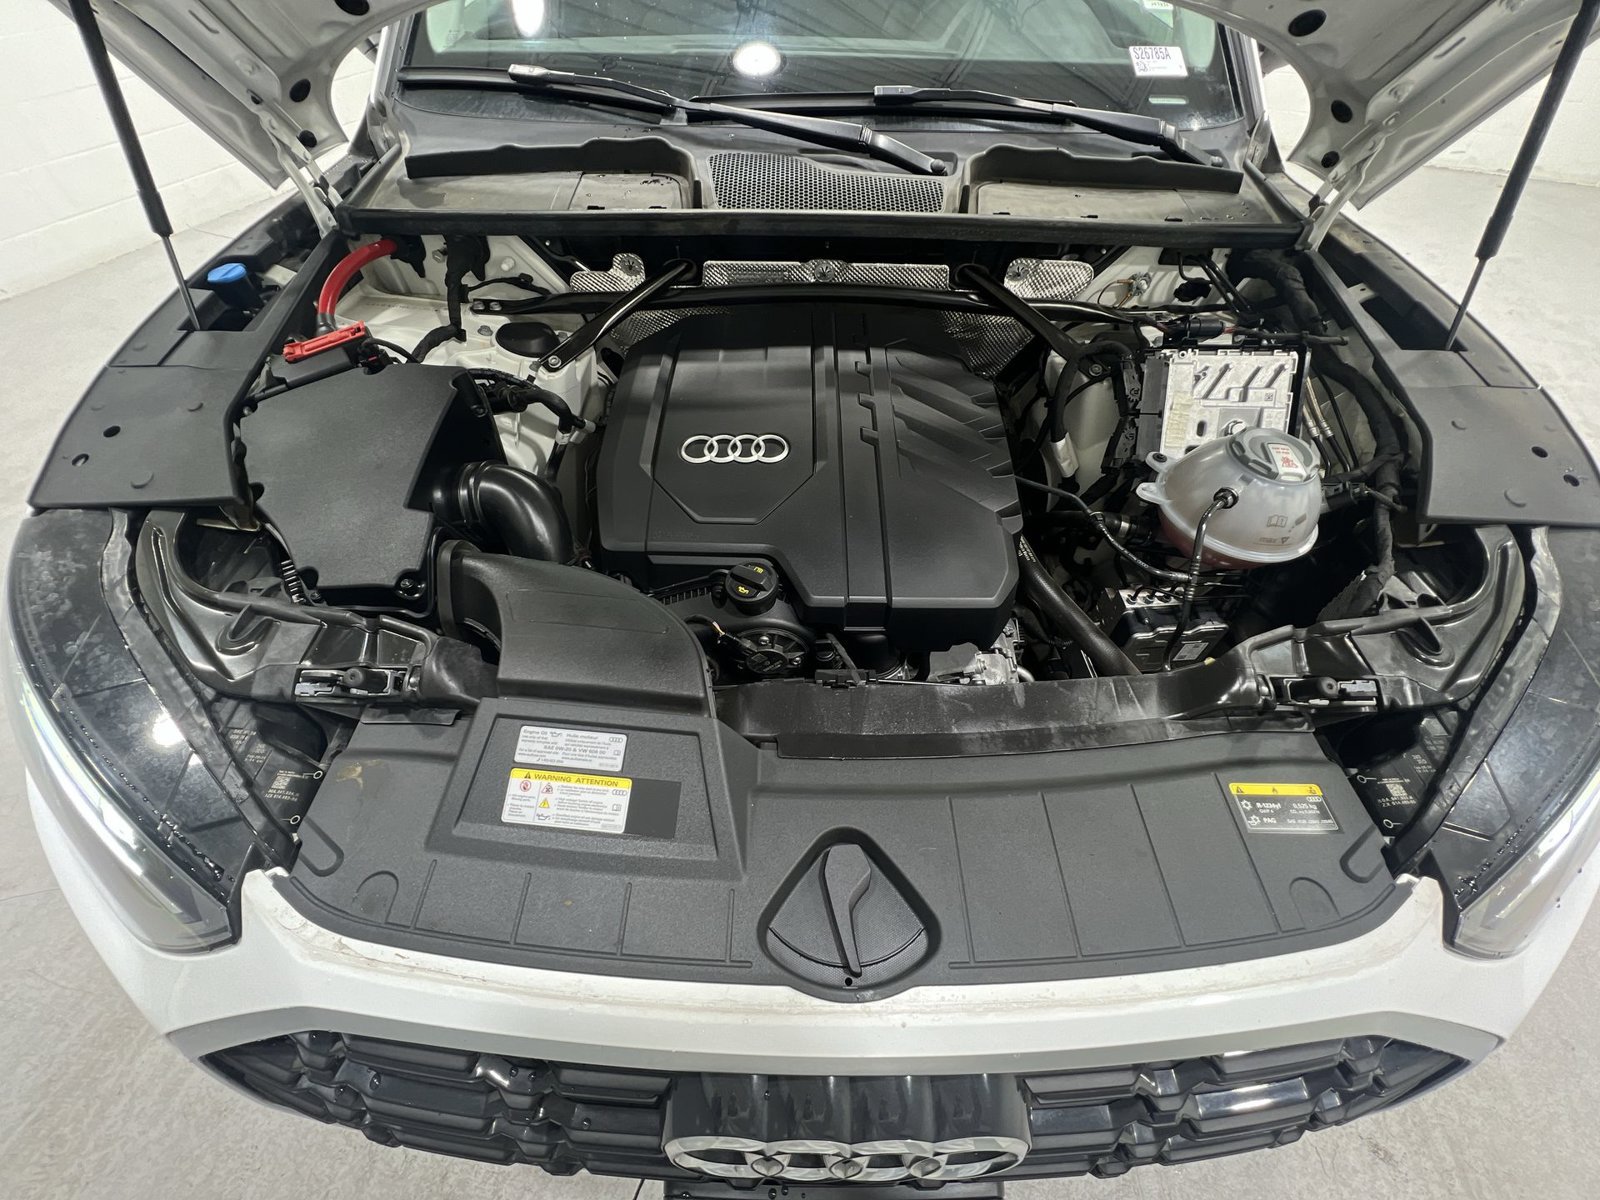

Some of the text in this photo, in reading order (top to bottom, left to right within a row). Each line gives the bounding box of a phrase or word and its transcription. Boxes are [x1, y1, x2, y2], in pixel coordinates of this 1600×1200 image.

[1132, 47, 1171, 60] S26785A
[534, 773, 619, 787] WARNING ATTENTION
